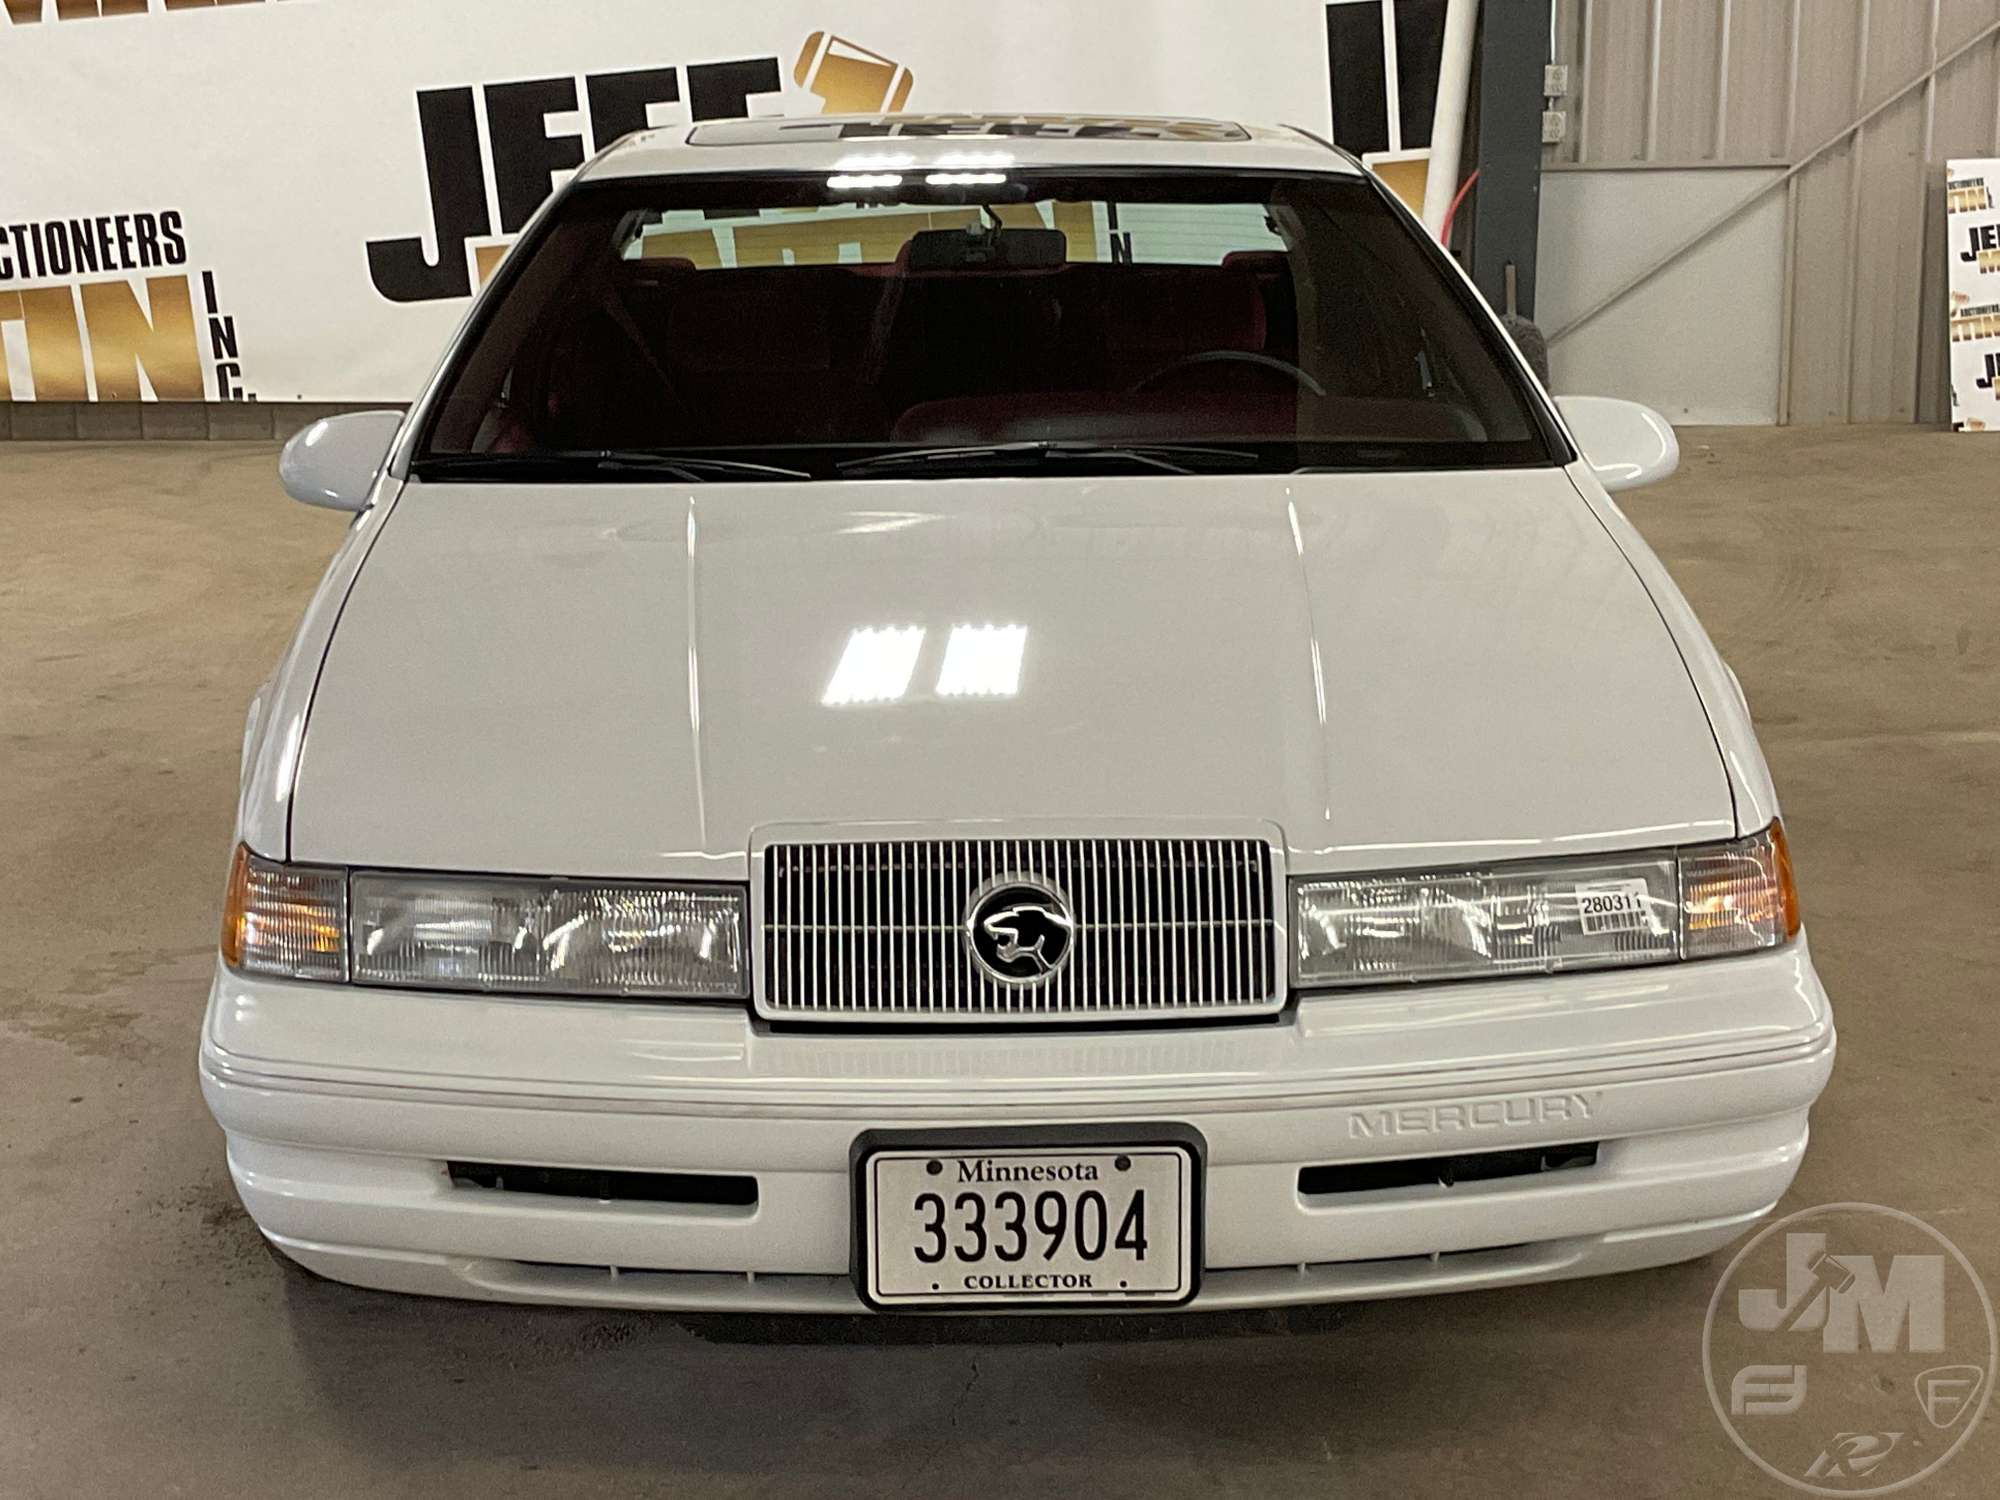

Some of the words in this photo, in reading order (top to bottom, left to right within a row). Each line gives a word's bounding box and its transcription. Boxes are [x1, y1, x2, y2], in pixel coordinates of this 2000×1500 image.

[1960, 224, 2000, 262] JE
[1348, 1091, 1603, 1138] MERCURY
[957, 1160, 1099, 1183] Minnesota
[914, 1189, 1148, 1263] 333904
[963, 1274, 1093, 1290] COLLECTOR
